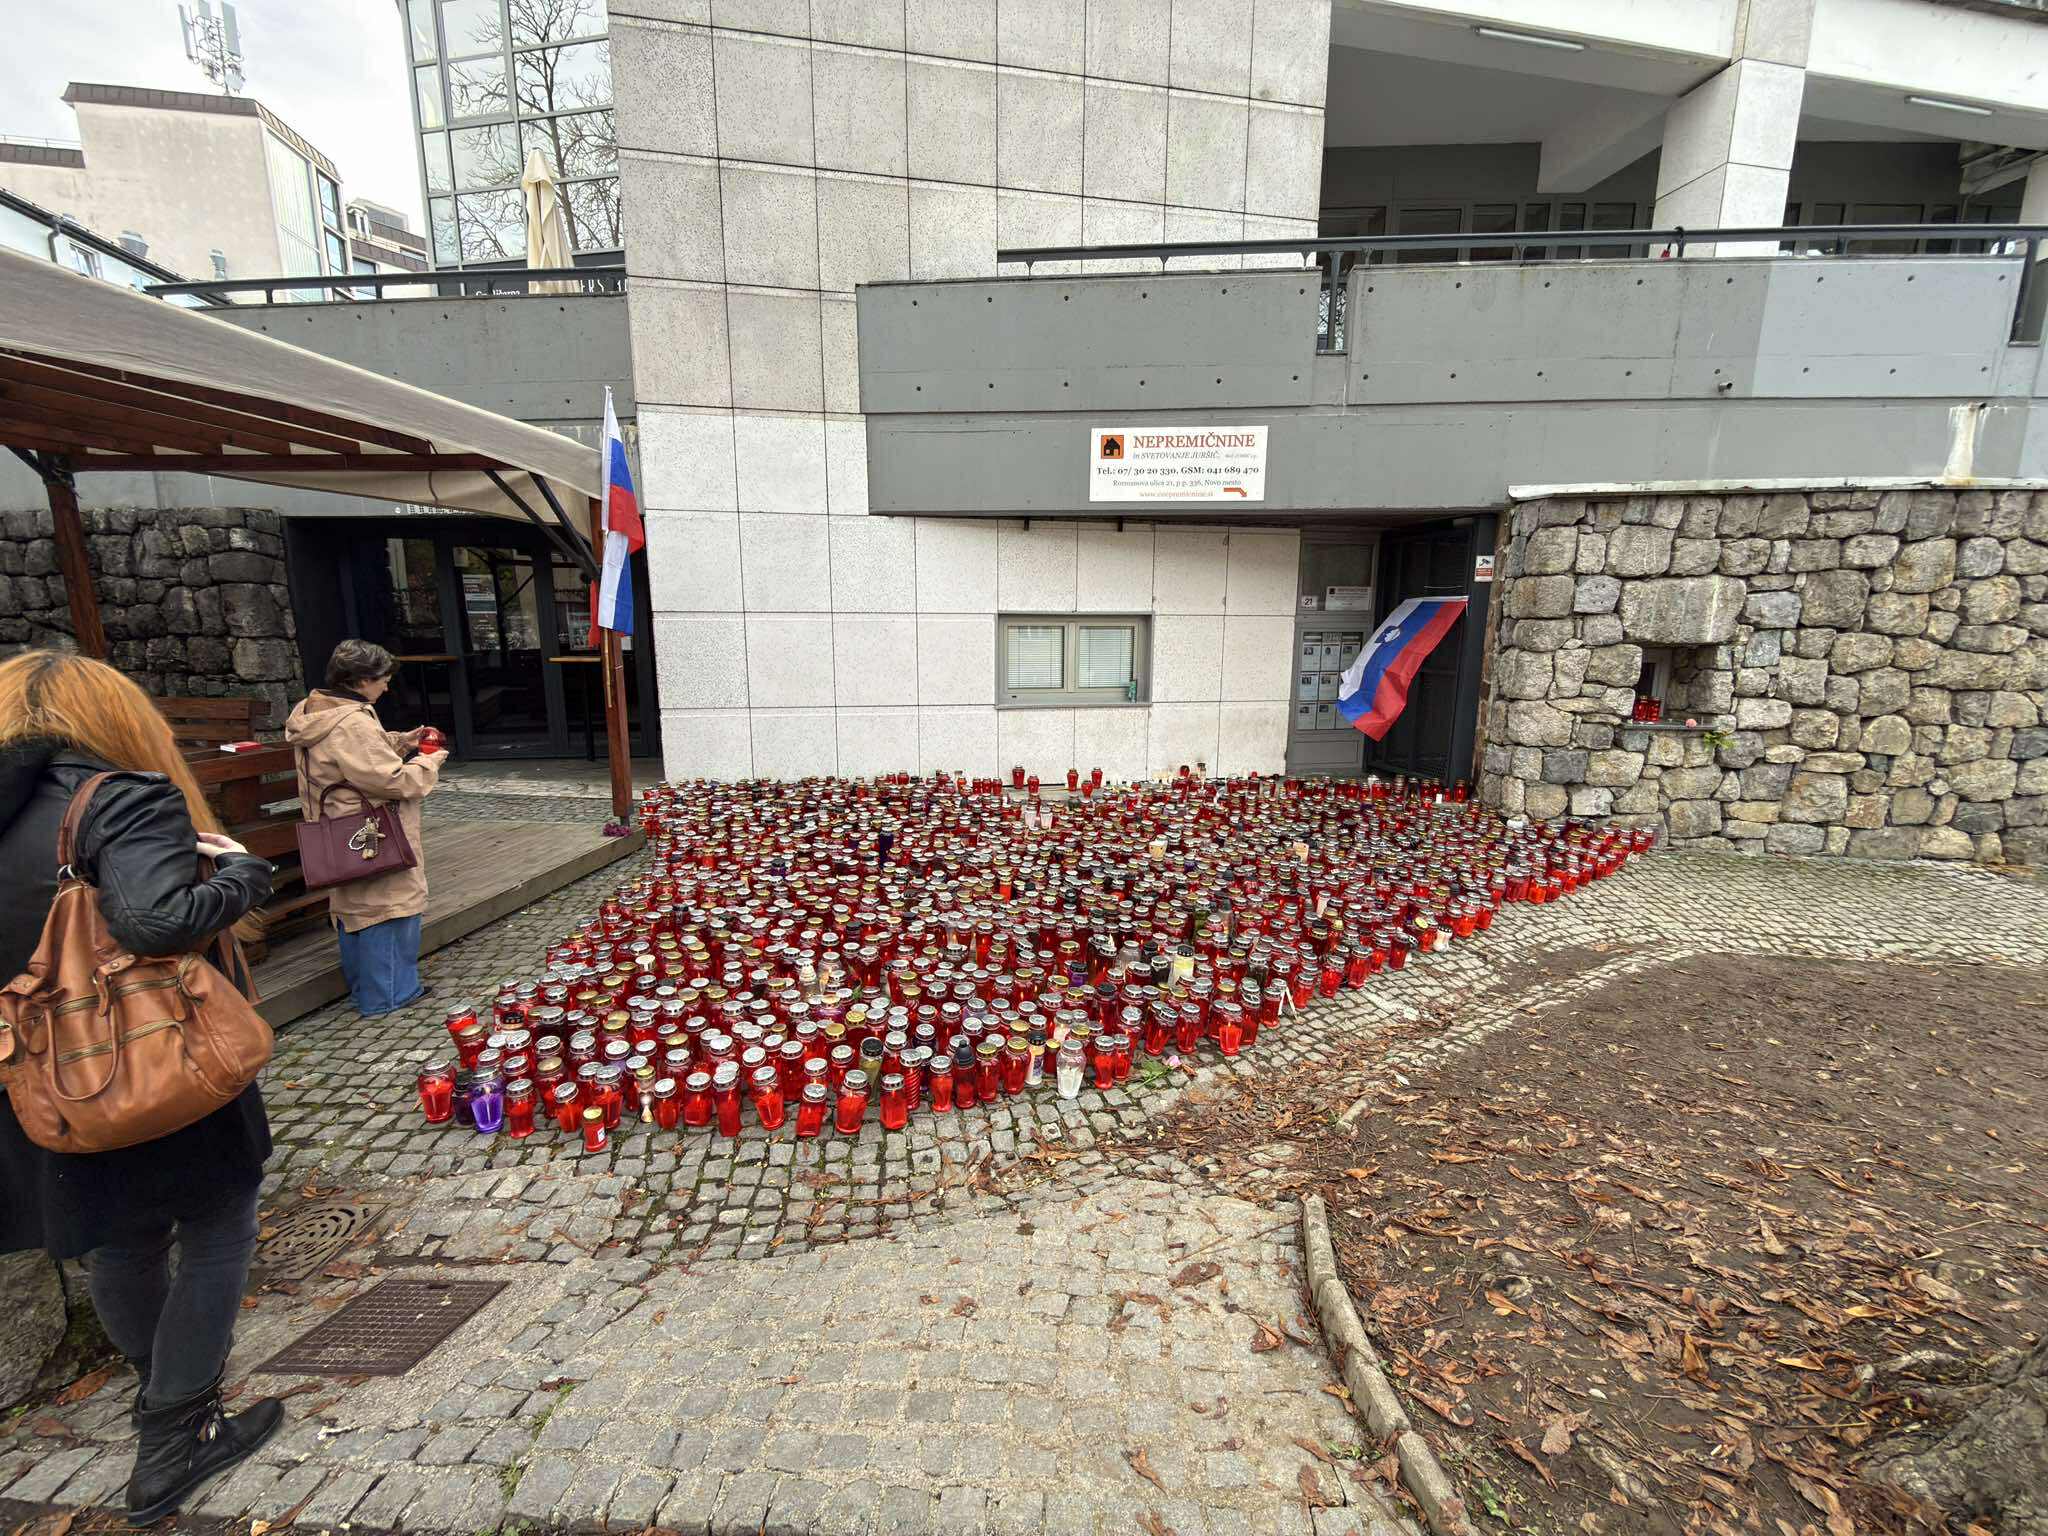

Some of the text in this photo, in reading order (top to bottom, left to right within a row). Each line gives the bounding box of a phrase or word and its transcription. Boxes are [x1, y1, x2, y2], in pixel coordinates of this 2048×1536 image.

[1133, 432, 1256, 449] NEPREMIČNINE
[1140, 452, 1190, 460] SVETOVANJE
[1097, 467, 1116, 475] Tel.:
[1181, 466, 1204, 475] GSM:
[1206, 467, 1222, 475] 041
[1224, 466, 1241, 476] 689
[1242, 467, 1260, 476] 470
[1204, 478, 1222, 487] Novo
[1222, 478, 1242, 487] mesto
